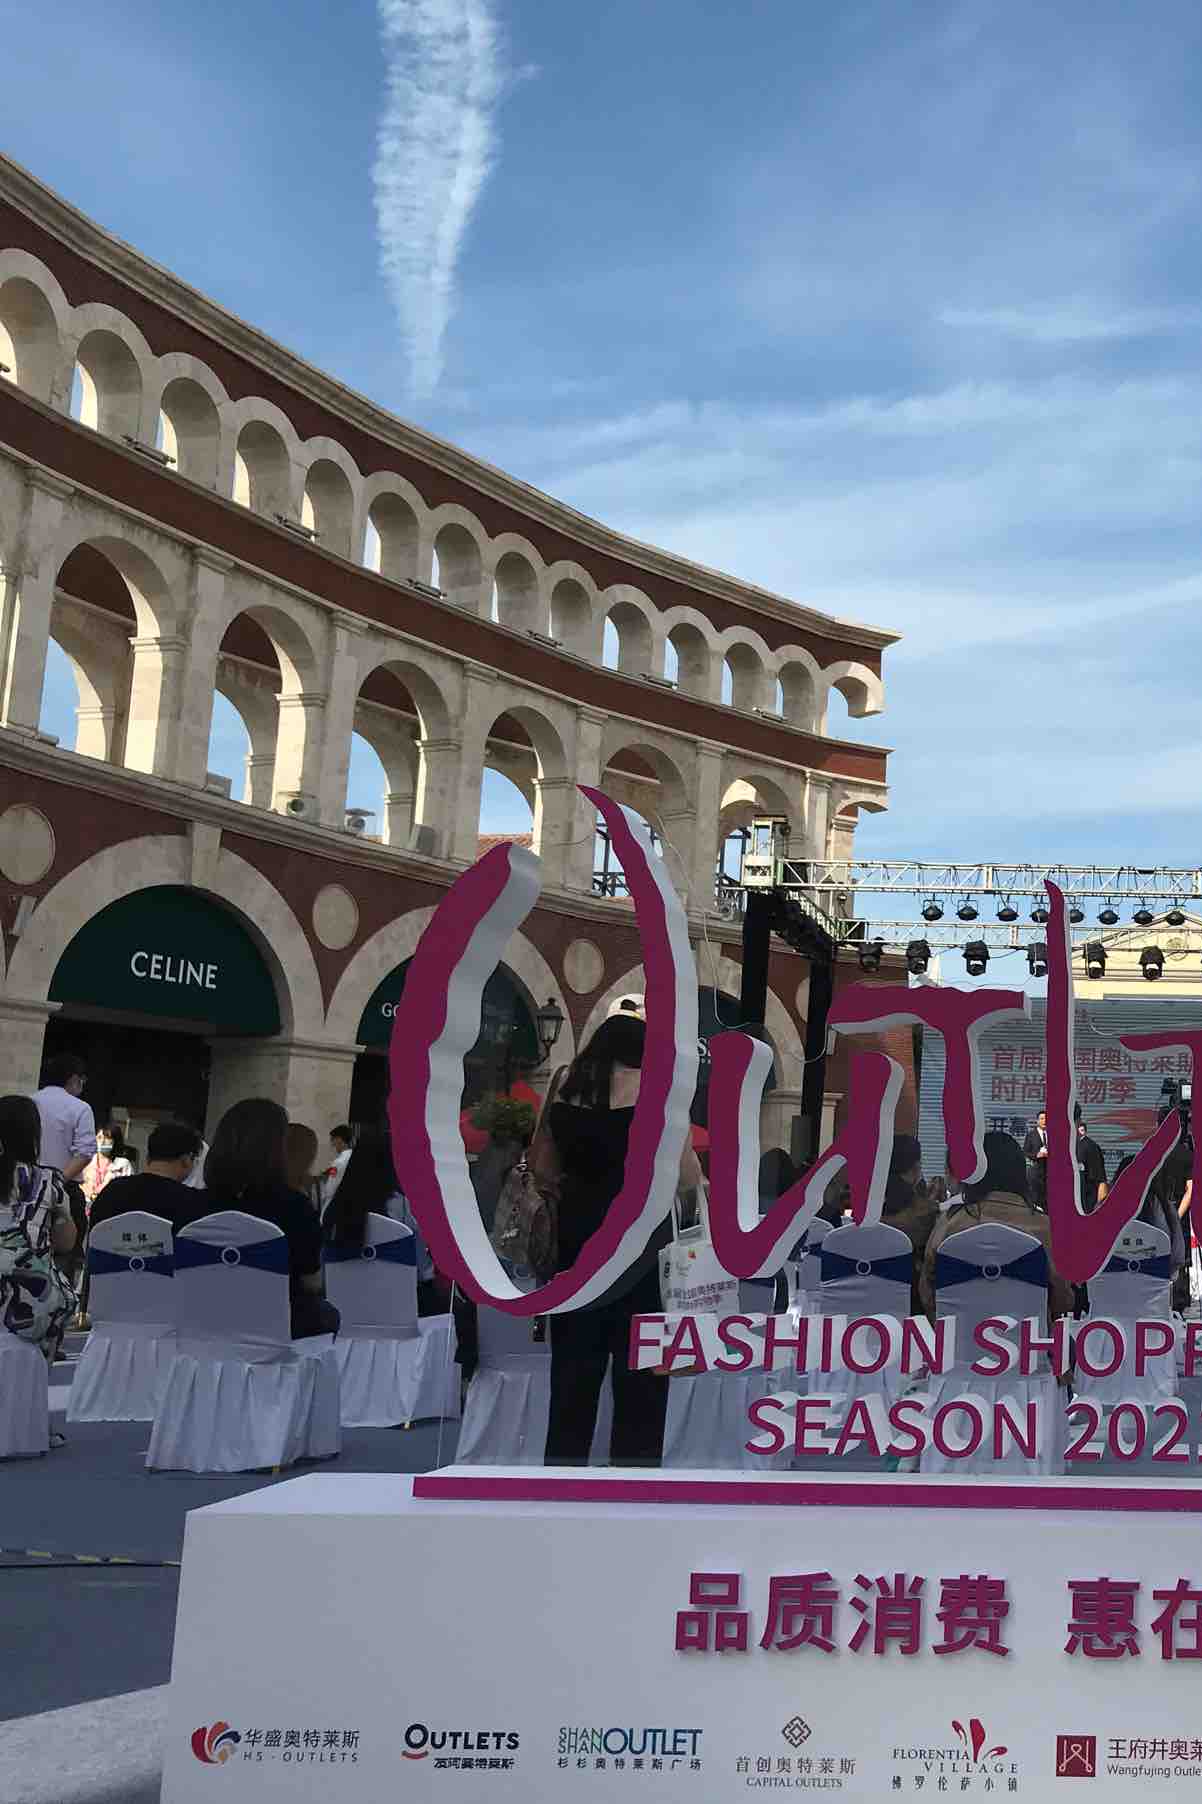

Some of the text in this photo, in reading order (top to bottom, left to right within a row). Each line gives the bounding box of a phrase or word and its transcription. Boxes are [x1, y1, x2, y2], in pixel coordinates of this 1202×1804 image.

[131, 951, 218, 989] CELINE
[628, 1313, 952, 1376] FASHION
[744, 1397, 1040, 1460] SEASON
[675, 1572, 1011, 1655] 品质消费
[244, 1729, 360, 1749] 华盛奥特莱斯
[404, 1723, 520, 1750] OUTLETS
[603, 1727, 703, 1755] OUTLET
[557, 1758, 703, 1769] 杉杉奥特莱斯广场
[893, 1748, 970, 1760] FLORENTIA
[736, 1756, 856, 1774] 首创奥特莱斯
[924, 1762, 1018, 1773] VILLAGE
[1107, 1765, 1171, 1777] Wangfujing
[746, 1777, 842, 1788] CAPITAL OUTLETS
